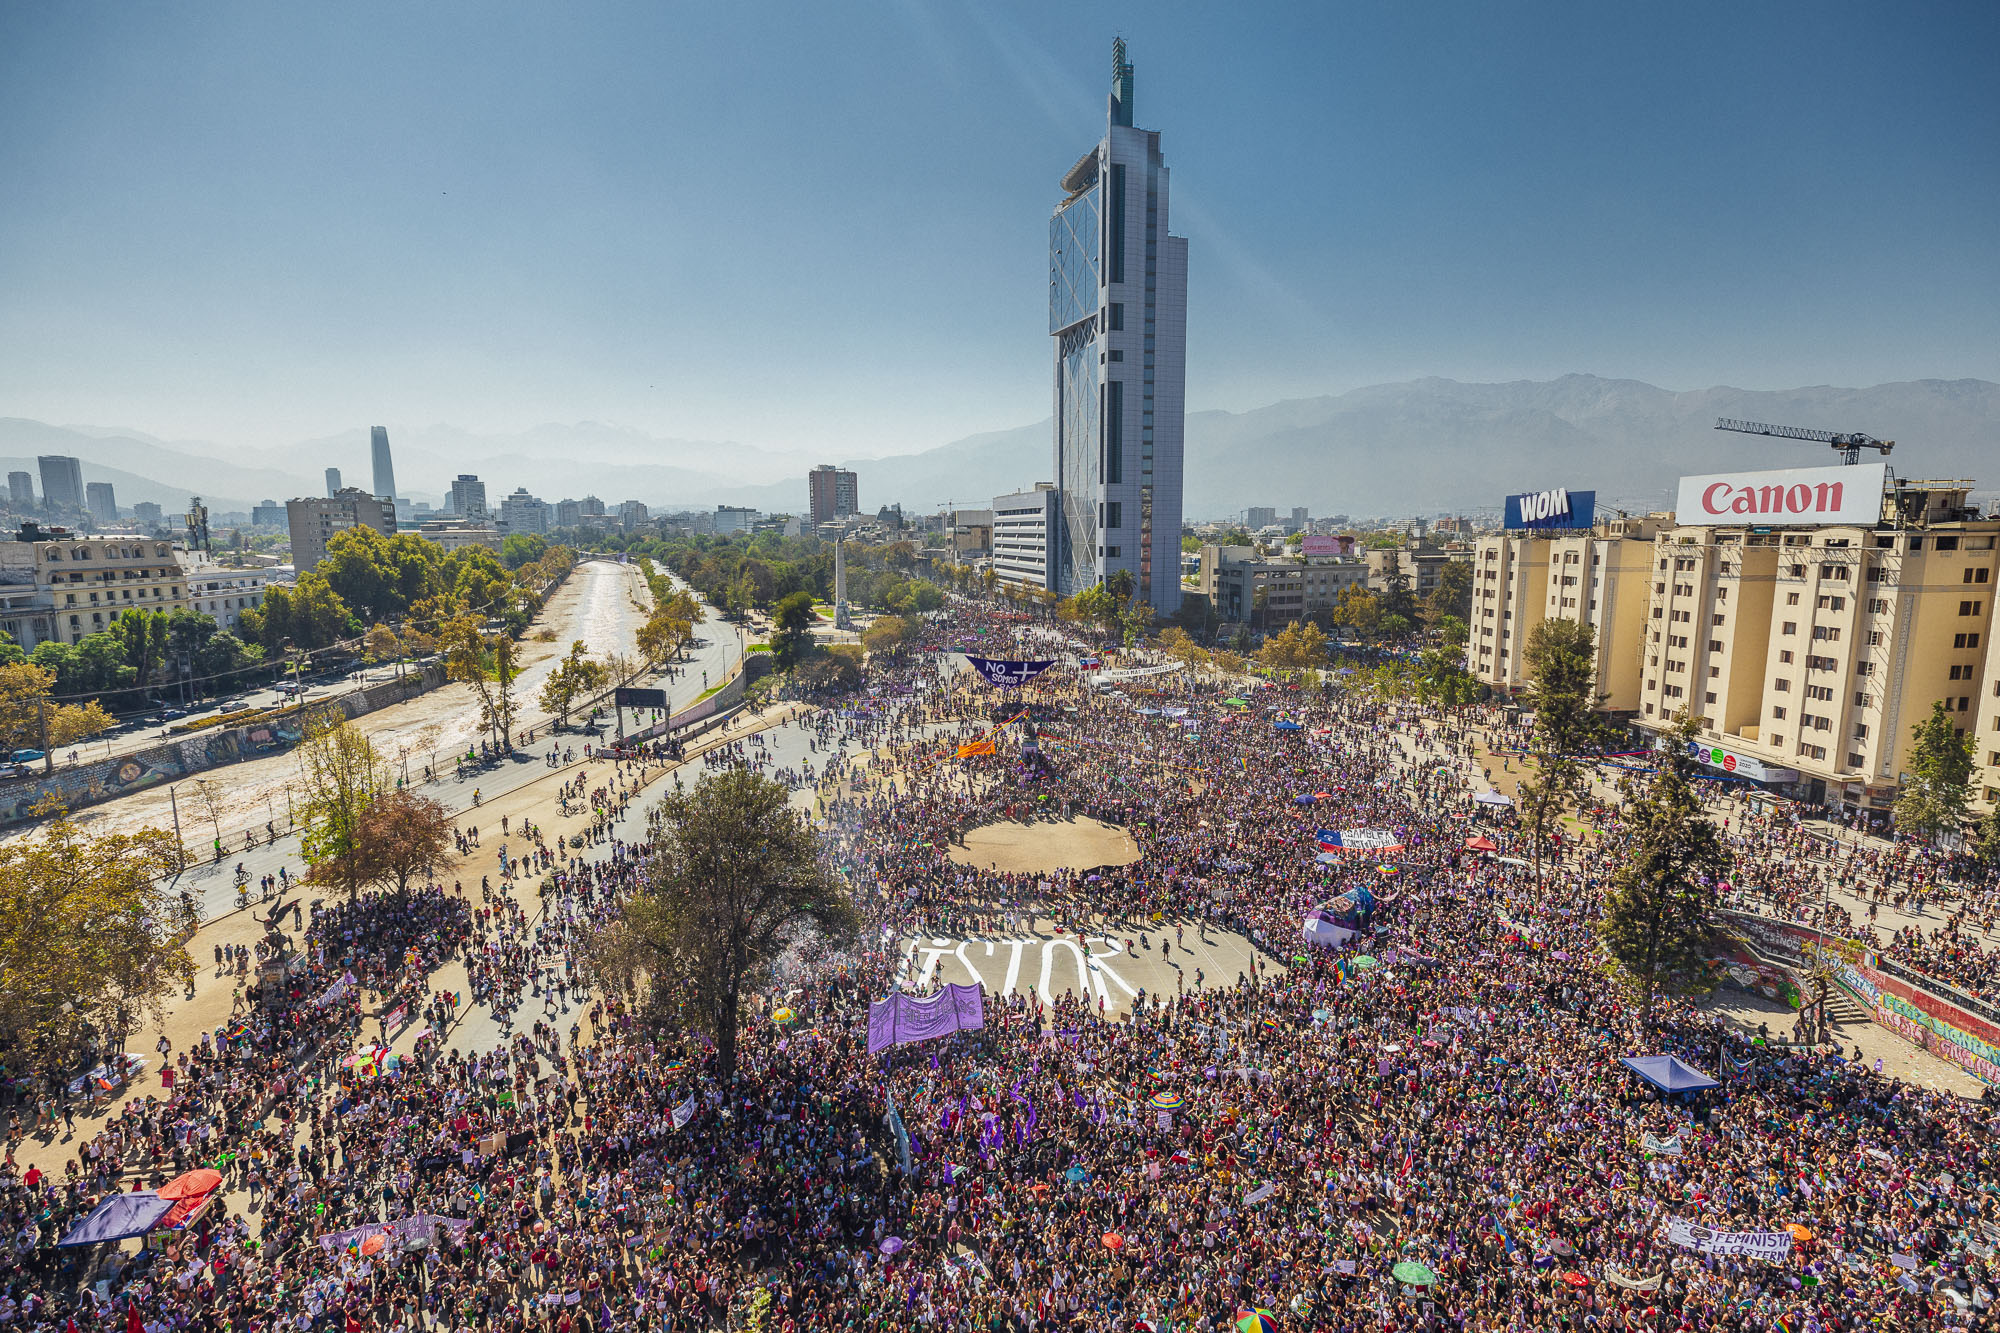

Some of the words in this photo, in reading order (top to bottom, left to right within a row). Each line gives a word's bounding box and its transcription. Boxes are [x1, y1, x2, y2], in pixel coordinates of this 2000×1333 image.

[1519, 487, 1568, 522] WOM
[1701, 481, 1844, 515] Canon
[985, 661, 1006, 675] NO
[991, 673, 1018, 684] SOMOS
[1739, 761, 1752, 769] 2020
[1341, 828, 1395, 840] ASAMBLEA
[1715, 1232, 1791, 1247] FEMINISTA
[1712, 1245, 1725, 1253] LA
